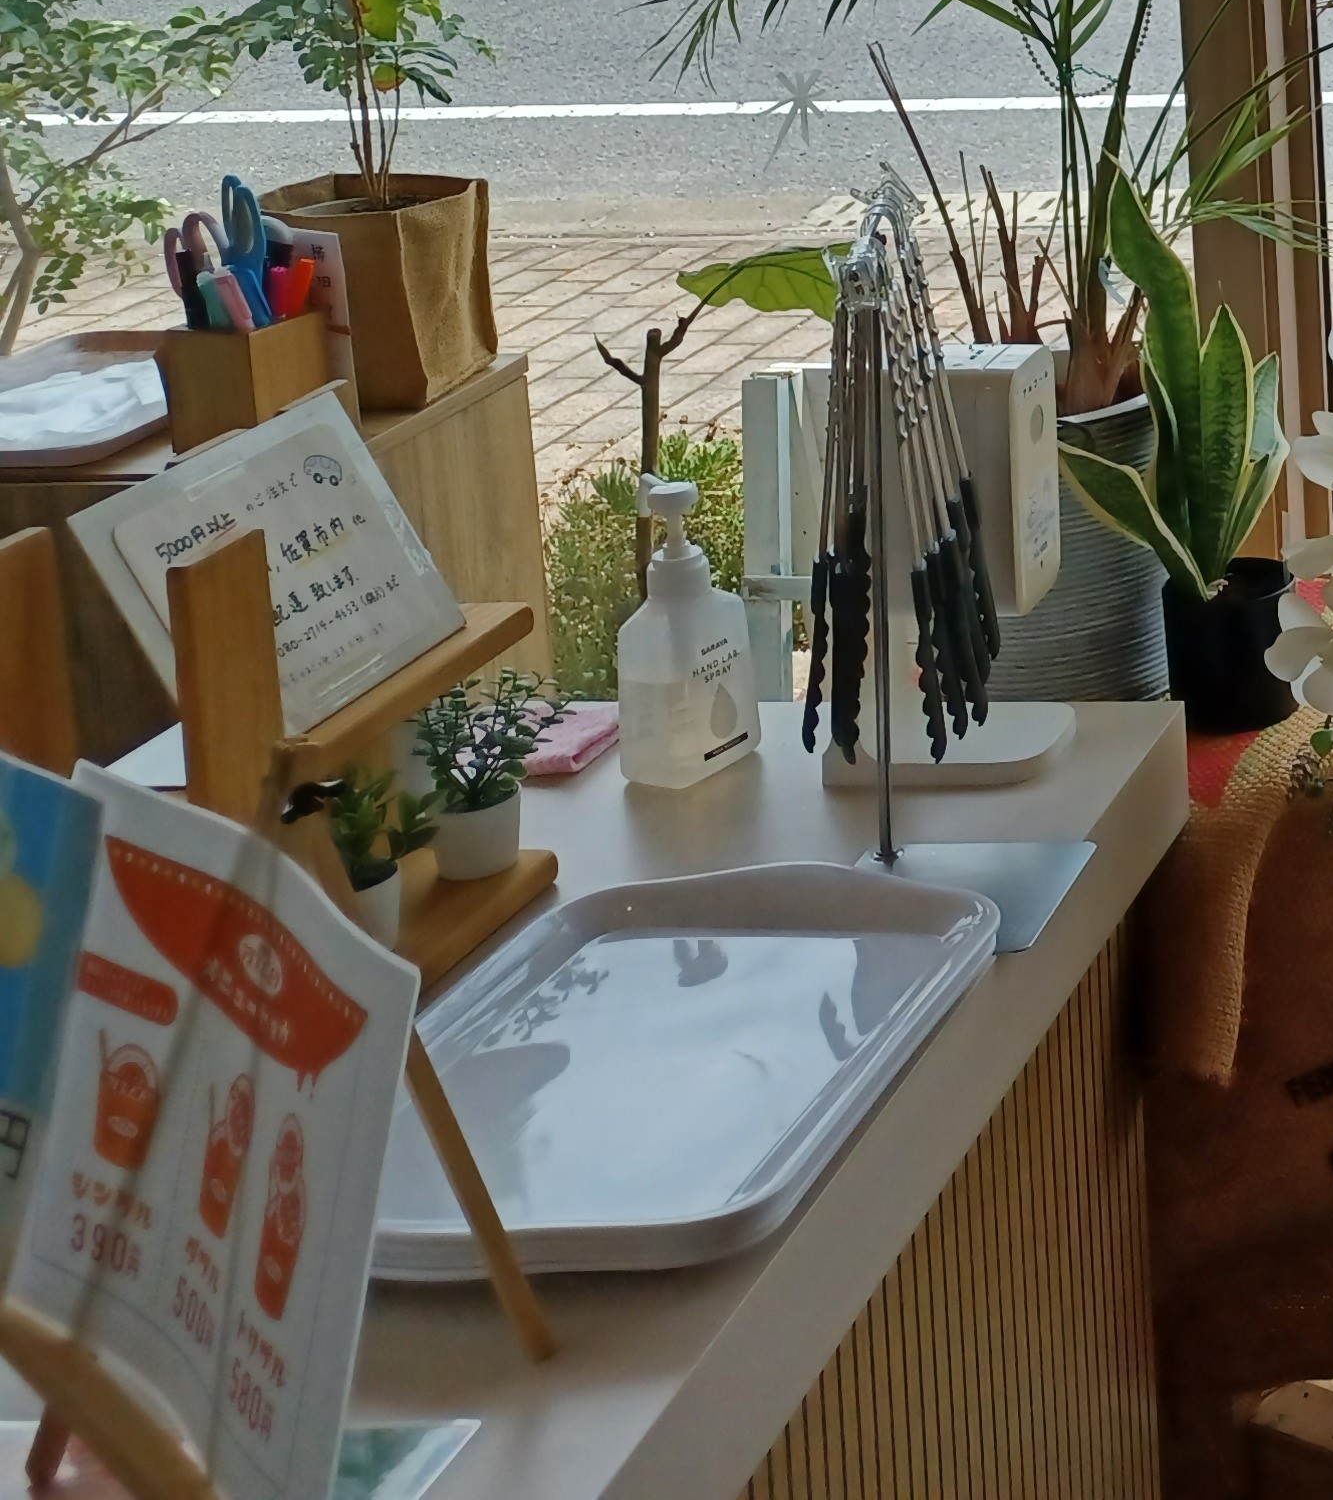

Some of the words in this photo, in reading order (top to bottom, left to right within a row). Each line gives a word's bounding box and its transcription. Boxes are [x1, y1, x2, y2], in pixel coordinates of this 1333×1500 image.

[700, 638, 728, 656] SARAYA
[692, 661, 719, 678] HAND
[704, 663, 732, 684] SPRAY
